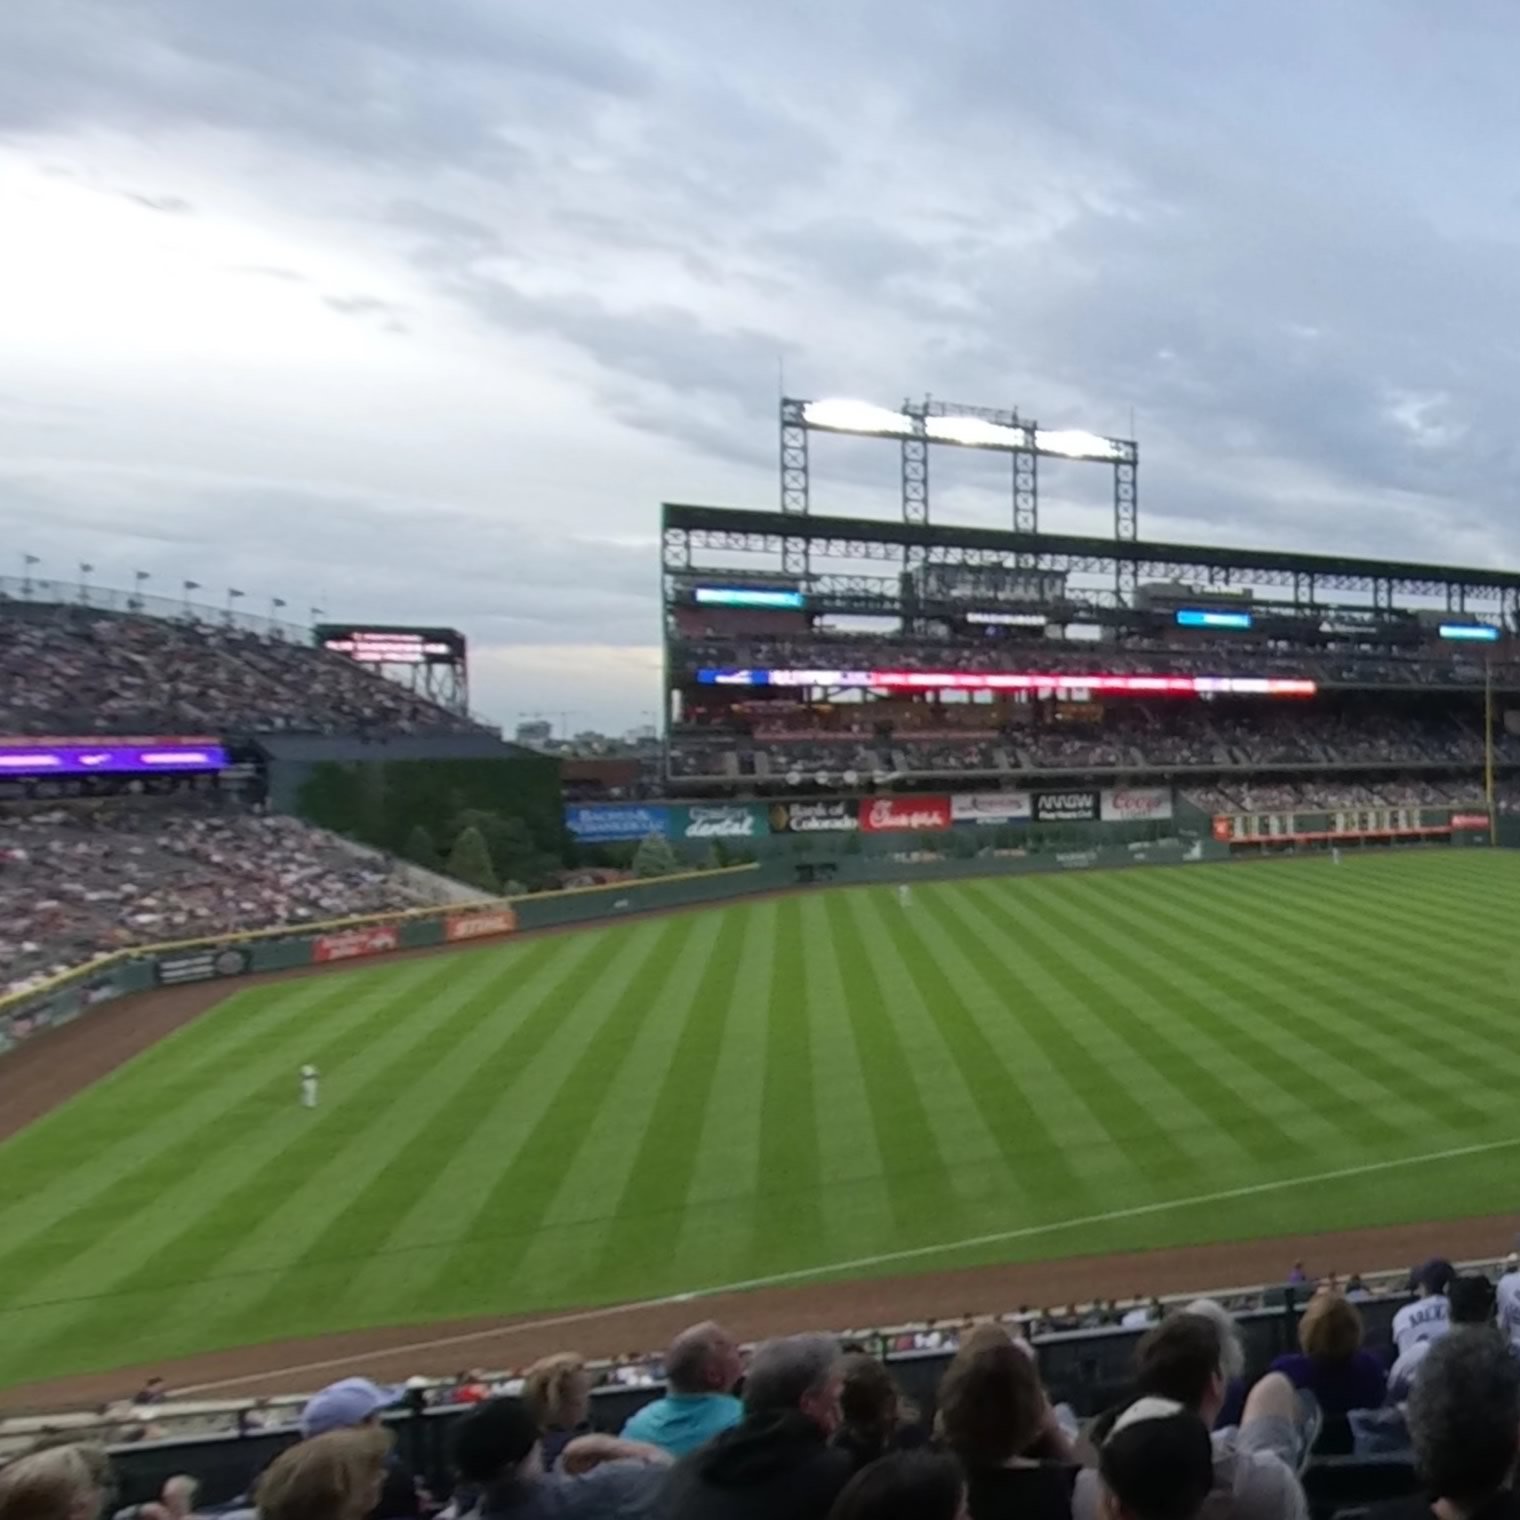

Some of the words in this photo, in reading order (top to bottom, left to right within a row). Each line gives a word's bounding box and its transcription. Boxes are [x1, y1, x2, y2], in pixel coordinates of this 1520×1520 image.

[789, 802, 826, 817] Bank
[829, 801, 846, 816] of
[1038, 794, 1094, 810] ARROW
[685, 815, 753, 837] dental
[789, 814, 858, 832] Colorado
